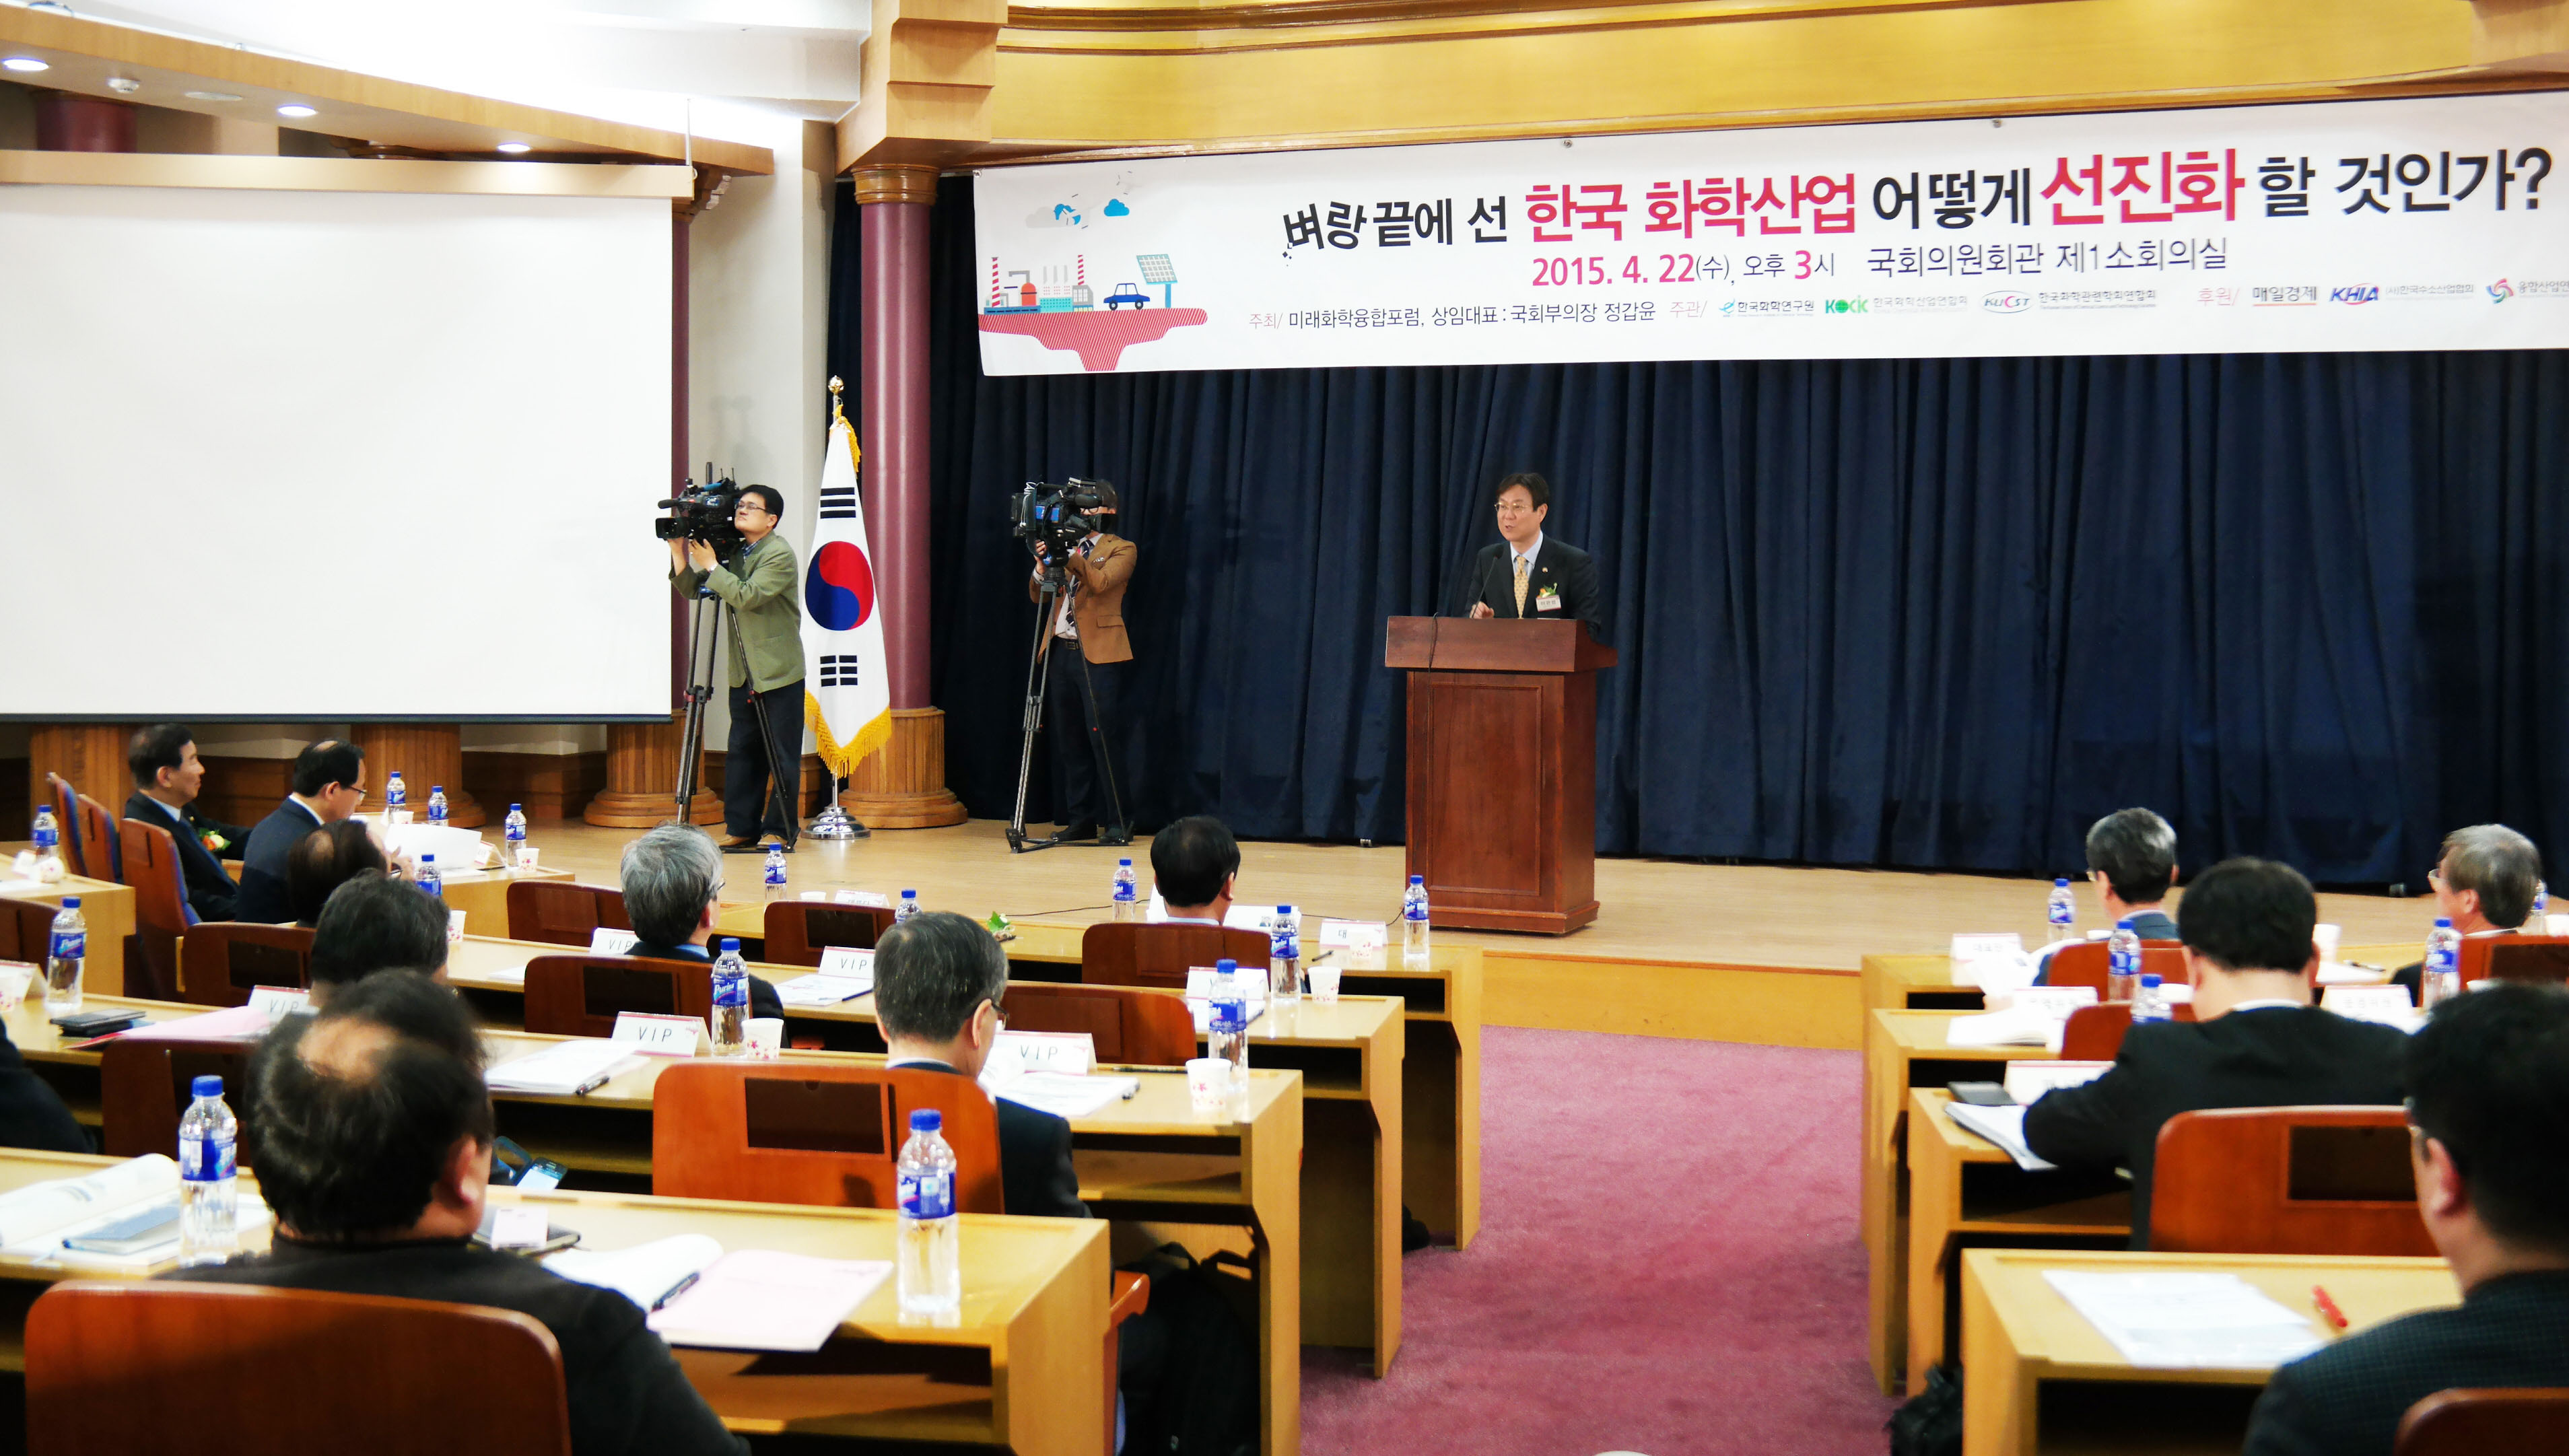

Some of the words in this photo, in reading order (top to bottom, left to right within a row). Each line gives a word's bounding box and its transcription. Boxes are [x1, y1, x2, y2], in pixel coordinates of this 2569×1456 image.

[1283, 201, 1367, 253] 벼랑
[1373, 199, 1452, 247] 끝에
[1468, 196, 1507, 243] 선
[1526, 184, 1628, 242] 한국
[1645, 173, 1855, 238] 화학산업
[1873, 168, 2030, 229] 어떻게
[2040, 148, 2246, 225] 선진화
[2258, 156, 2316, 217] 할
[2335, 146, 2554, 215] 것인가?
[1533, 256, 1612, 285] 2015.
[1622, 256, 1647, 283] 4.
[1744, 254, 1785, 277] 오후
[1795, 250, 1833, 279] 3시
[1868, 243, 2044, 277] 국회의원회관
[2056, 238, 2226, 273] 제1소회의실
[2253, 285, 2317, 302] 매일경제
[2329, 286, 2379, 303] KHIA
[1738, 300, 1814, 312] 한국화학연구원
[1290, 308, 1424, 328] 미래화학융합포럼,
[1511, 303, 1598, 323] 국회부의장
[1605, 302, 1655, 322] 정갑윤
[609, 938, 632, 951] VIP
[840, 957, 868, 970] VIP
[269, 998, 300, 1013] VIP
[638, 1026, 673, 1043] VIP
[1020, 1044, 1058, 1060] VIP
